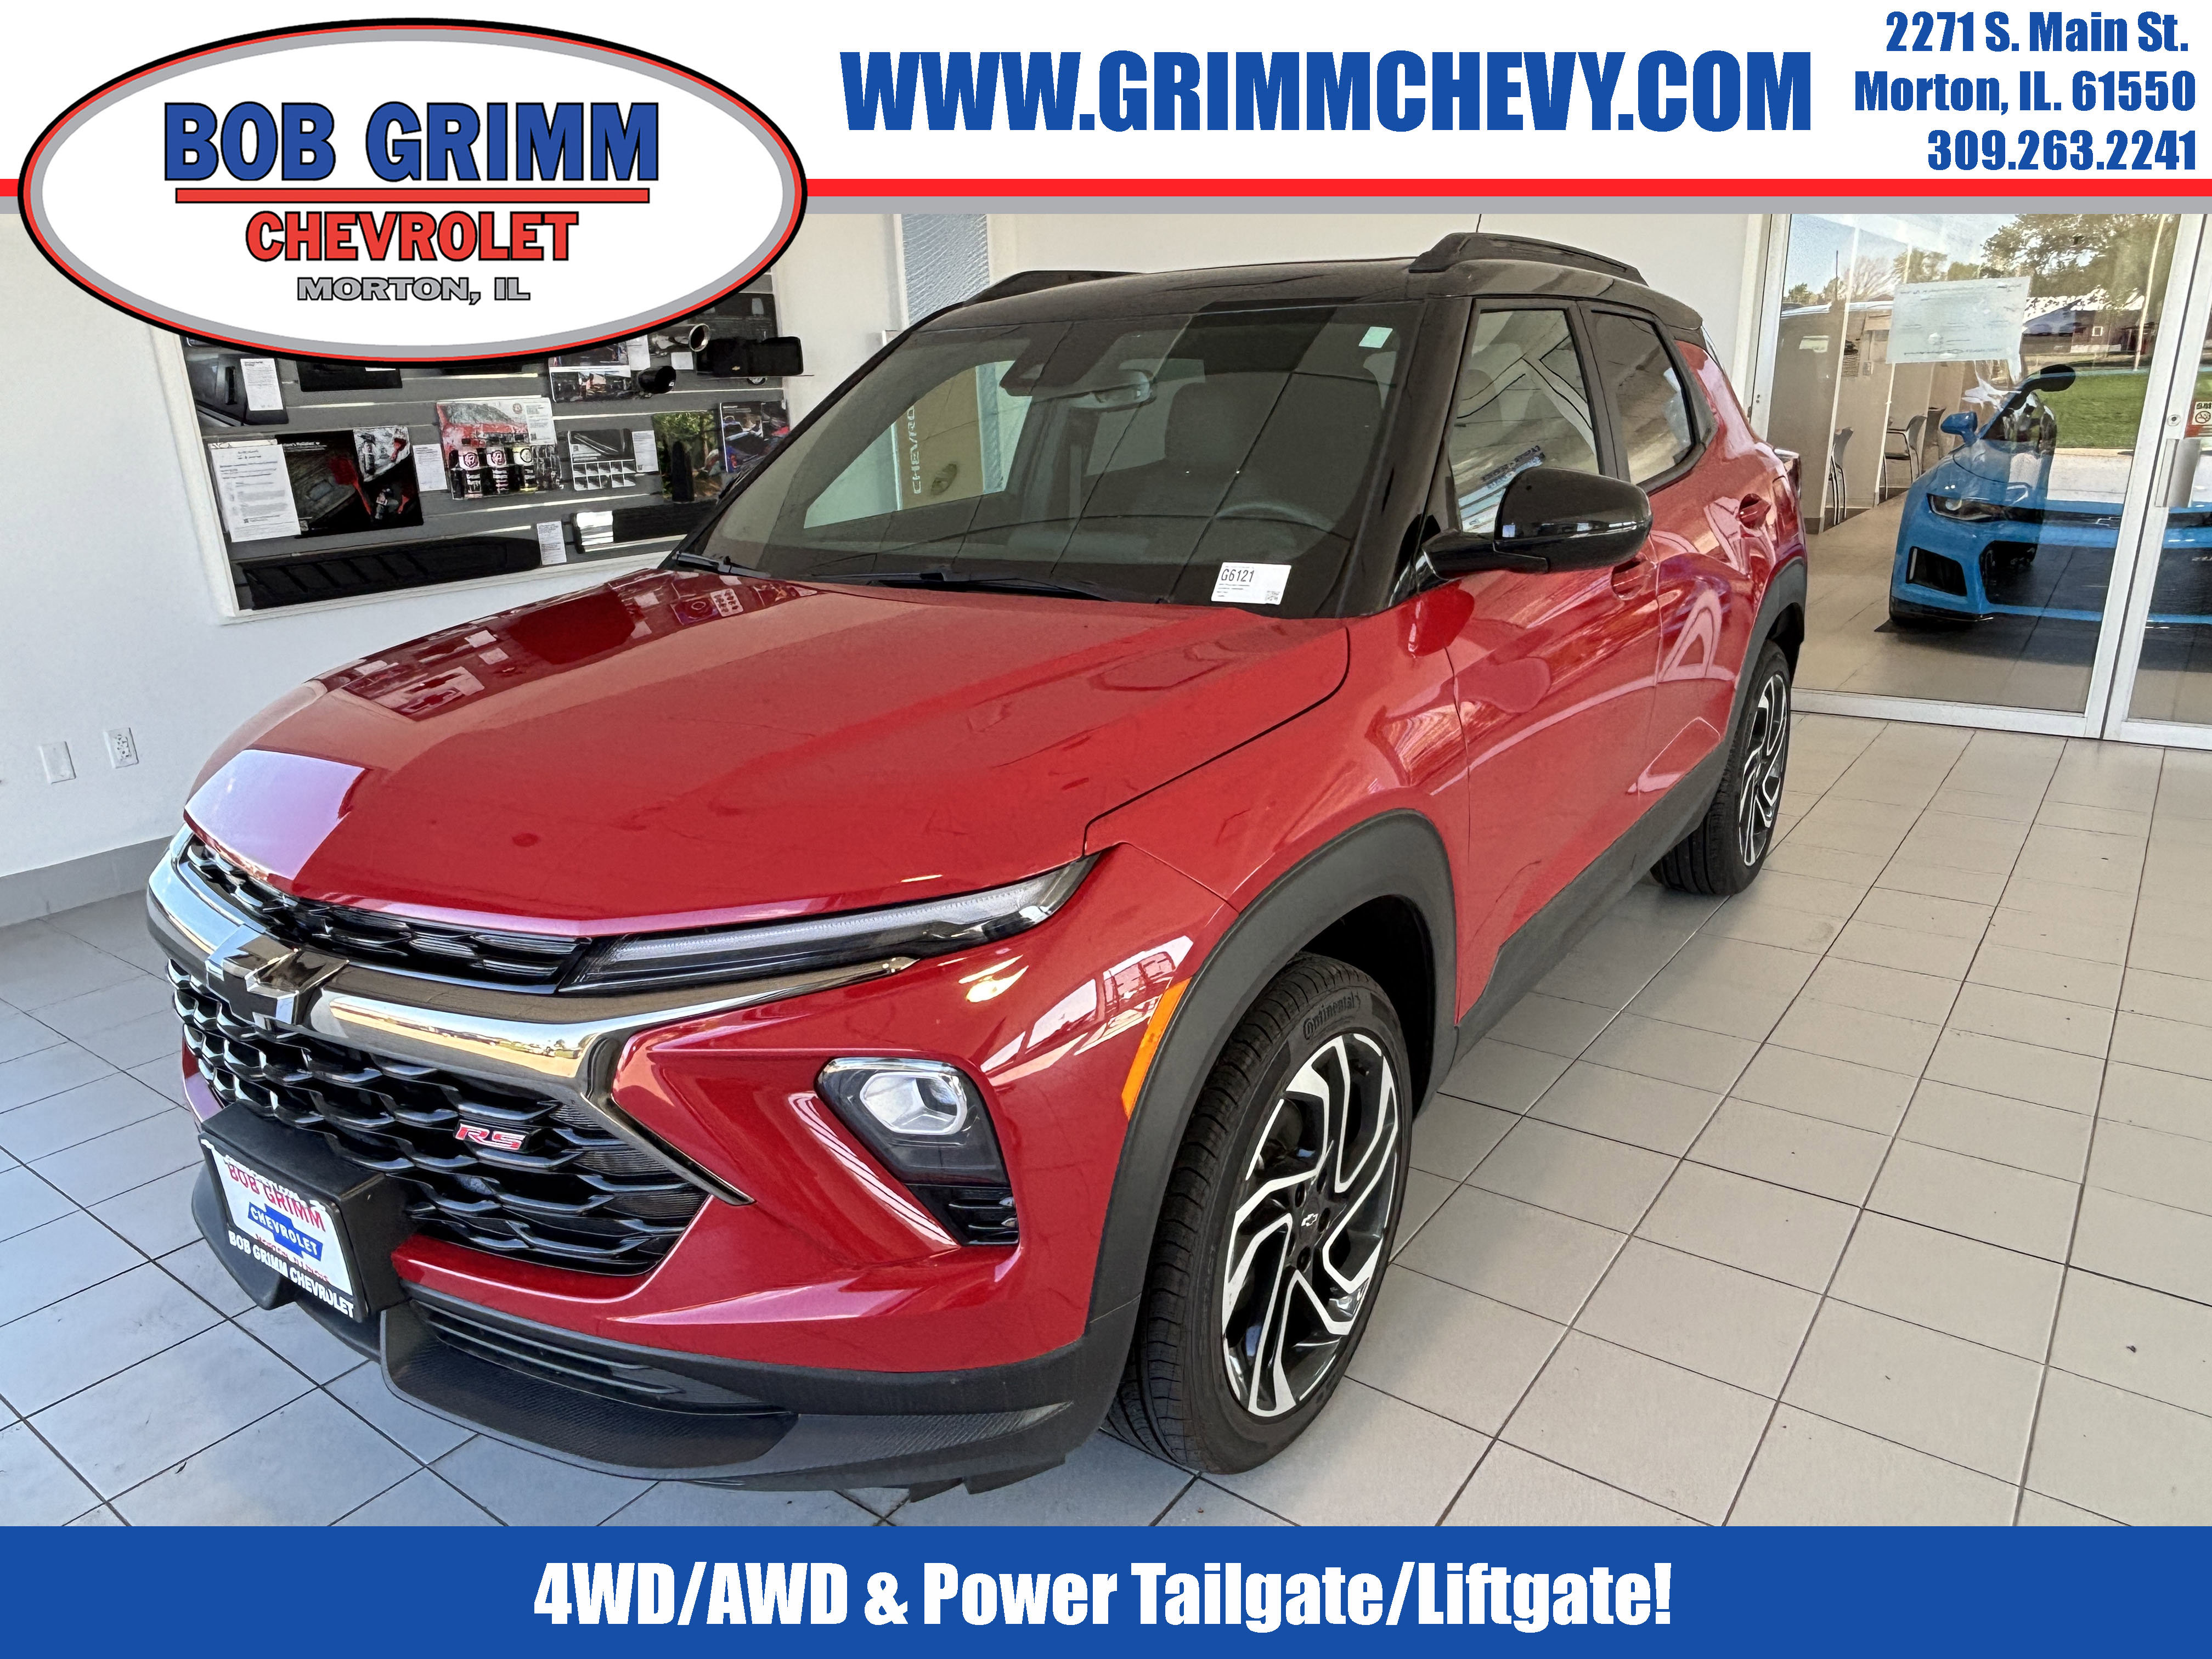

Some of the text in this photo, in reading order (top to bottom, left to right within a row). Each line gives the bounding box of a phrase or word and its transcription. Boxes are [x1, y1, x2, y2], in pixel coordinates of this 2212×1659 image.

[1221, 568, 1255, 583] G6121
[1302, 991, 1355, 1040] Continental
[455, 1123, 527, 1150] RS
[228, 1163, 325, 1232] BOB GRIMM
[250, 1206, 318, 1256] CHEVROLET
[228, 1231, 251, 1255] BOB
[252, 1244, 289, 1278] GRIMM
[290, 1267, 354, 1318] CHEVROLET
